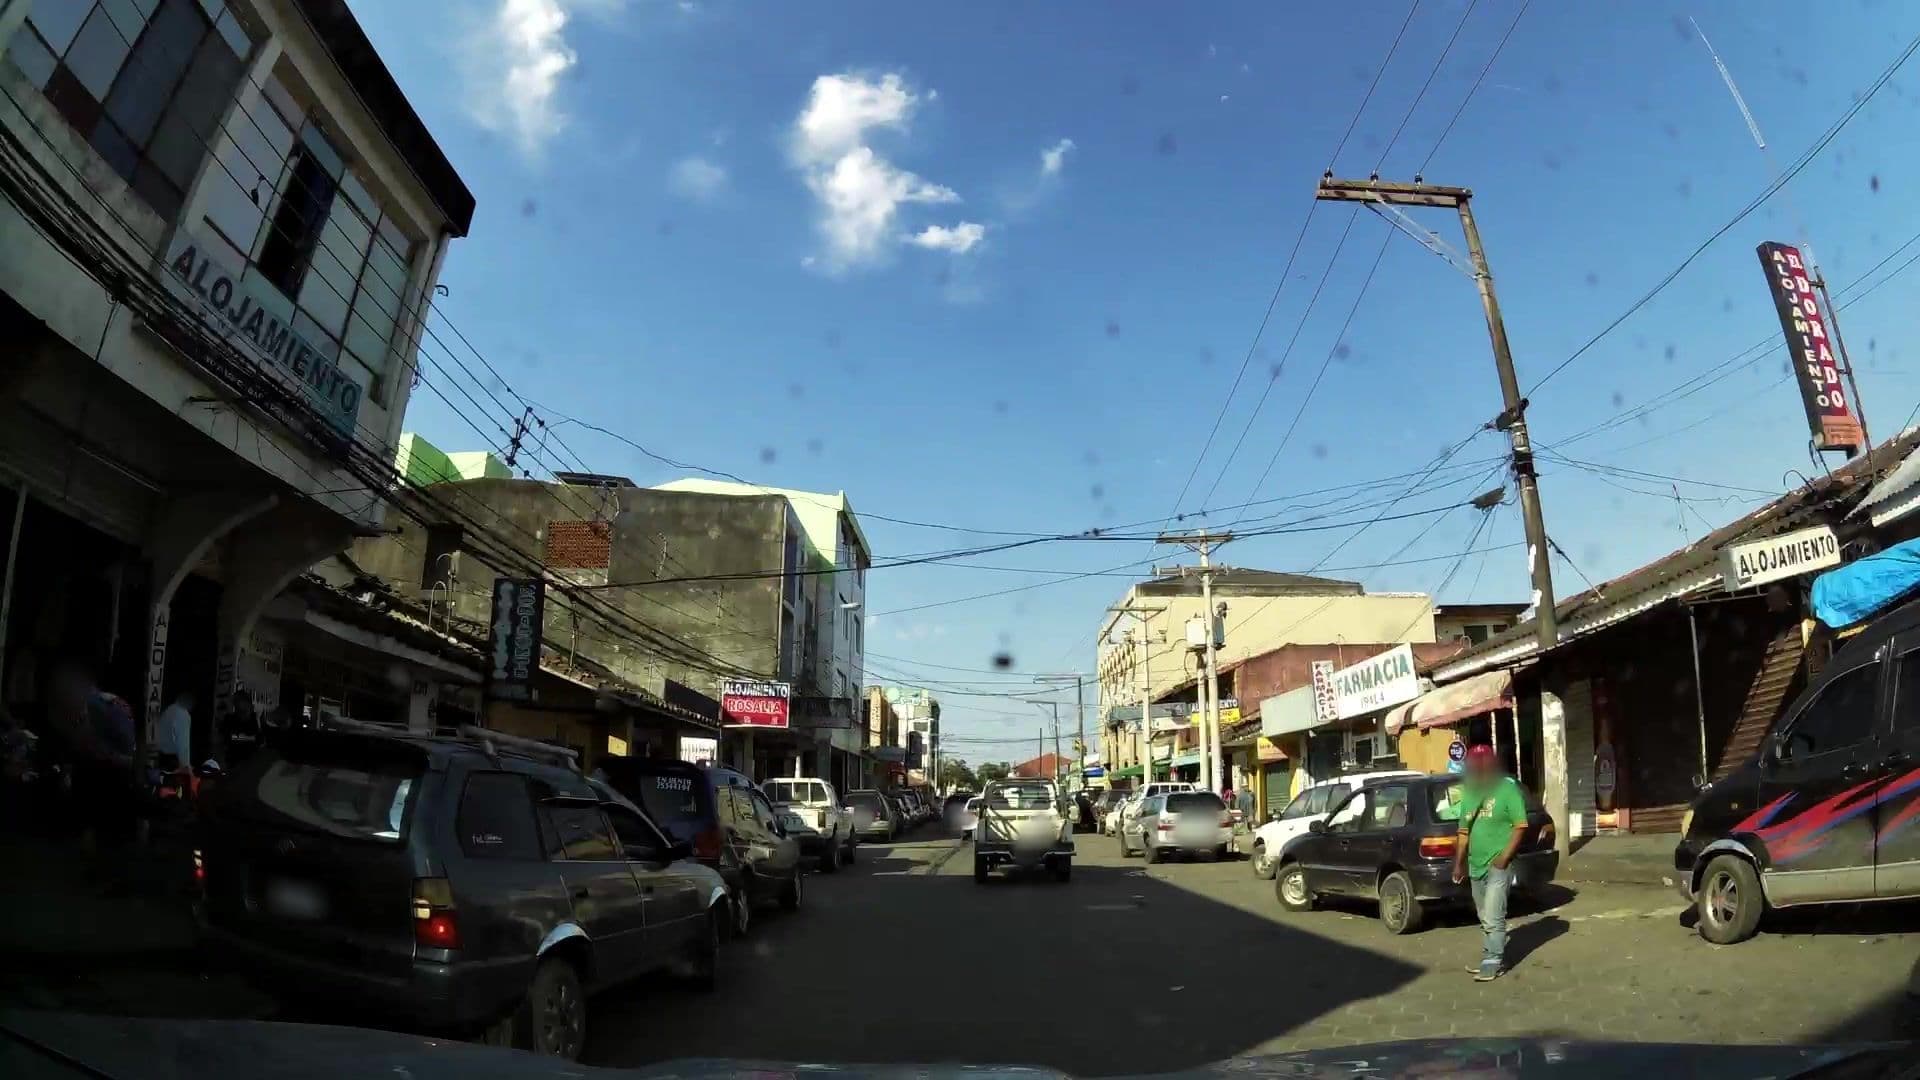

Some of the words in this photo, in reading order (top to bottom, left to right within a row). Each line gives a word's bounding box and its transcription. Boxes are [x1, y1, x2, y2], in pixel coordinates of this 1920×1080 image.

[172, 245, 359, 415] ALOJAMIENTO
[1773, 250, 1830, 408] ALOJAMIENTO
[1796, 276, 1844, 408] DORADO
[1739, 534, 1835, 577] ALOJAMIENTO
[724, 682, 788, 698] ALOJAMIENTO
[1315, 663, 1328, 719] FARMACIA
[1337, 654, 1411, 697] FARMACIA
[727, 699, 783, 715] ROSALIA
